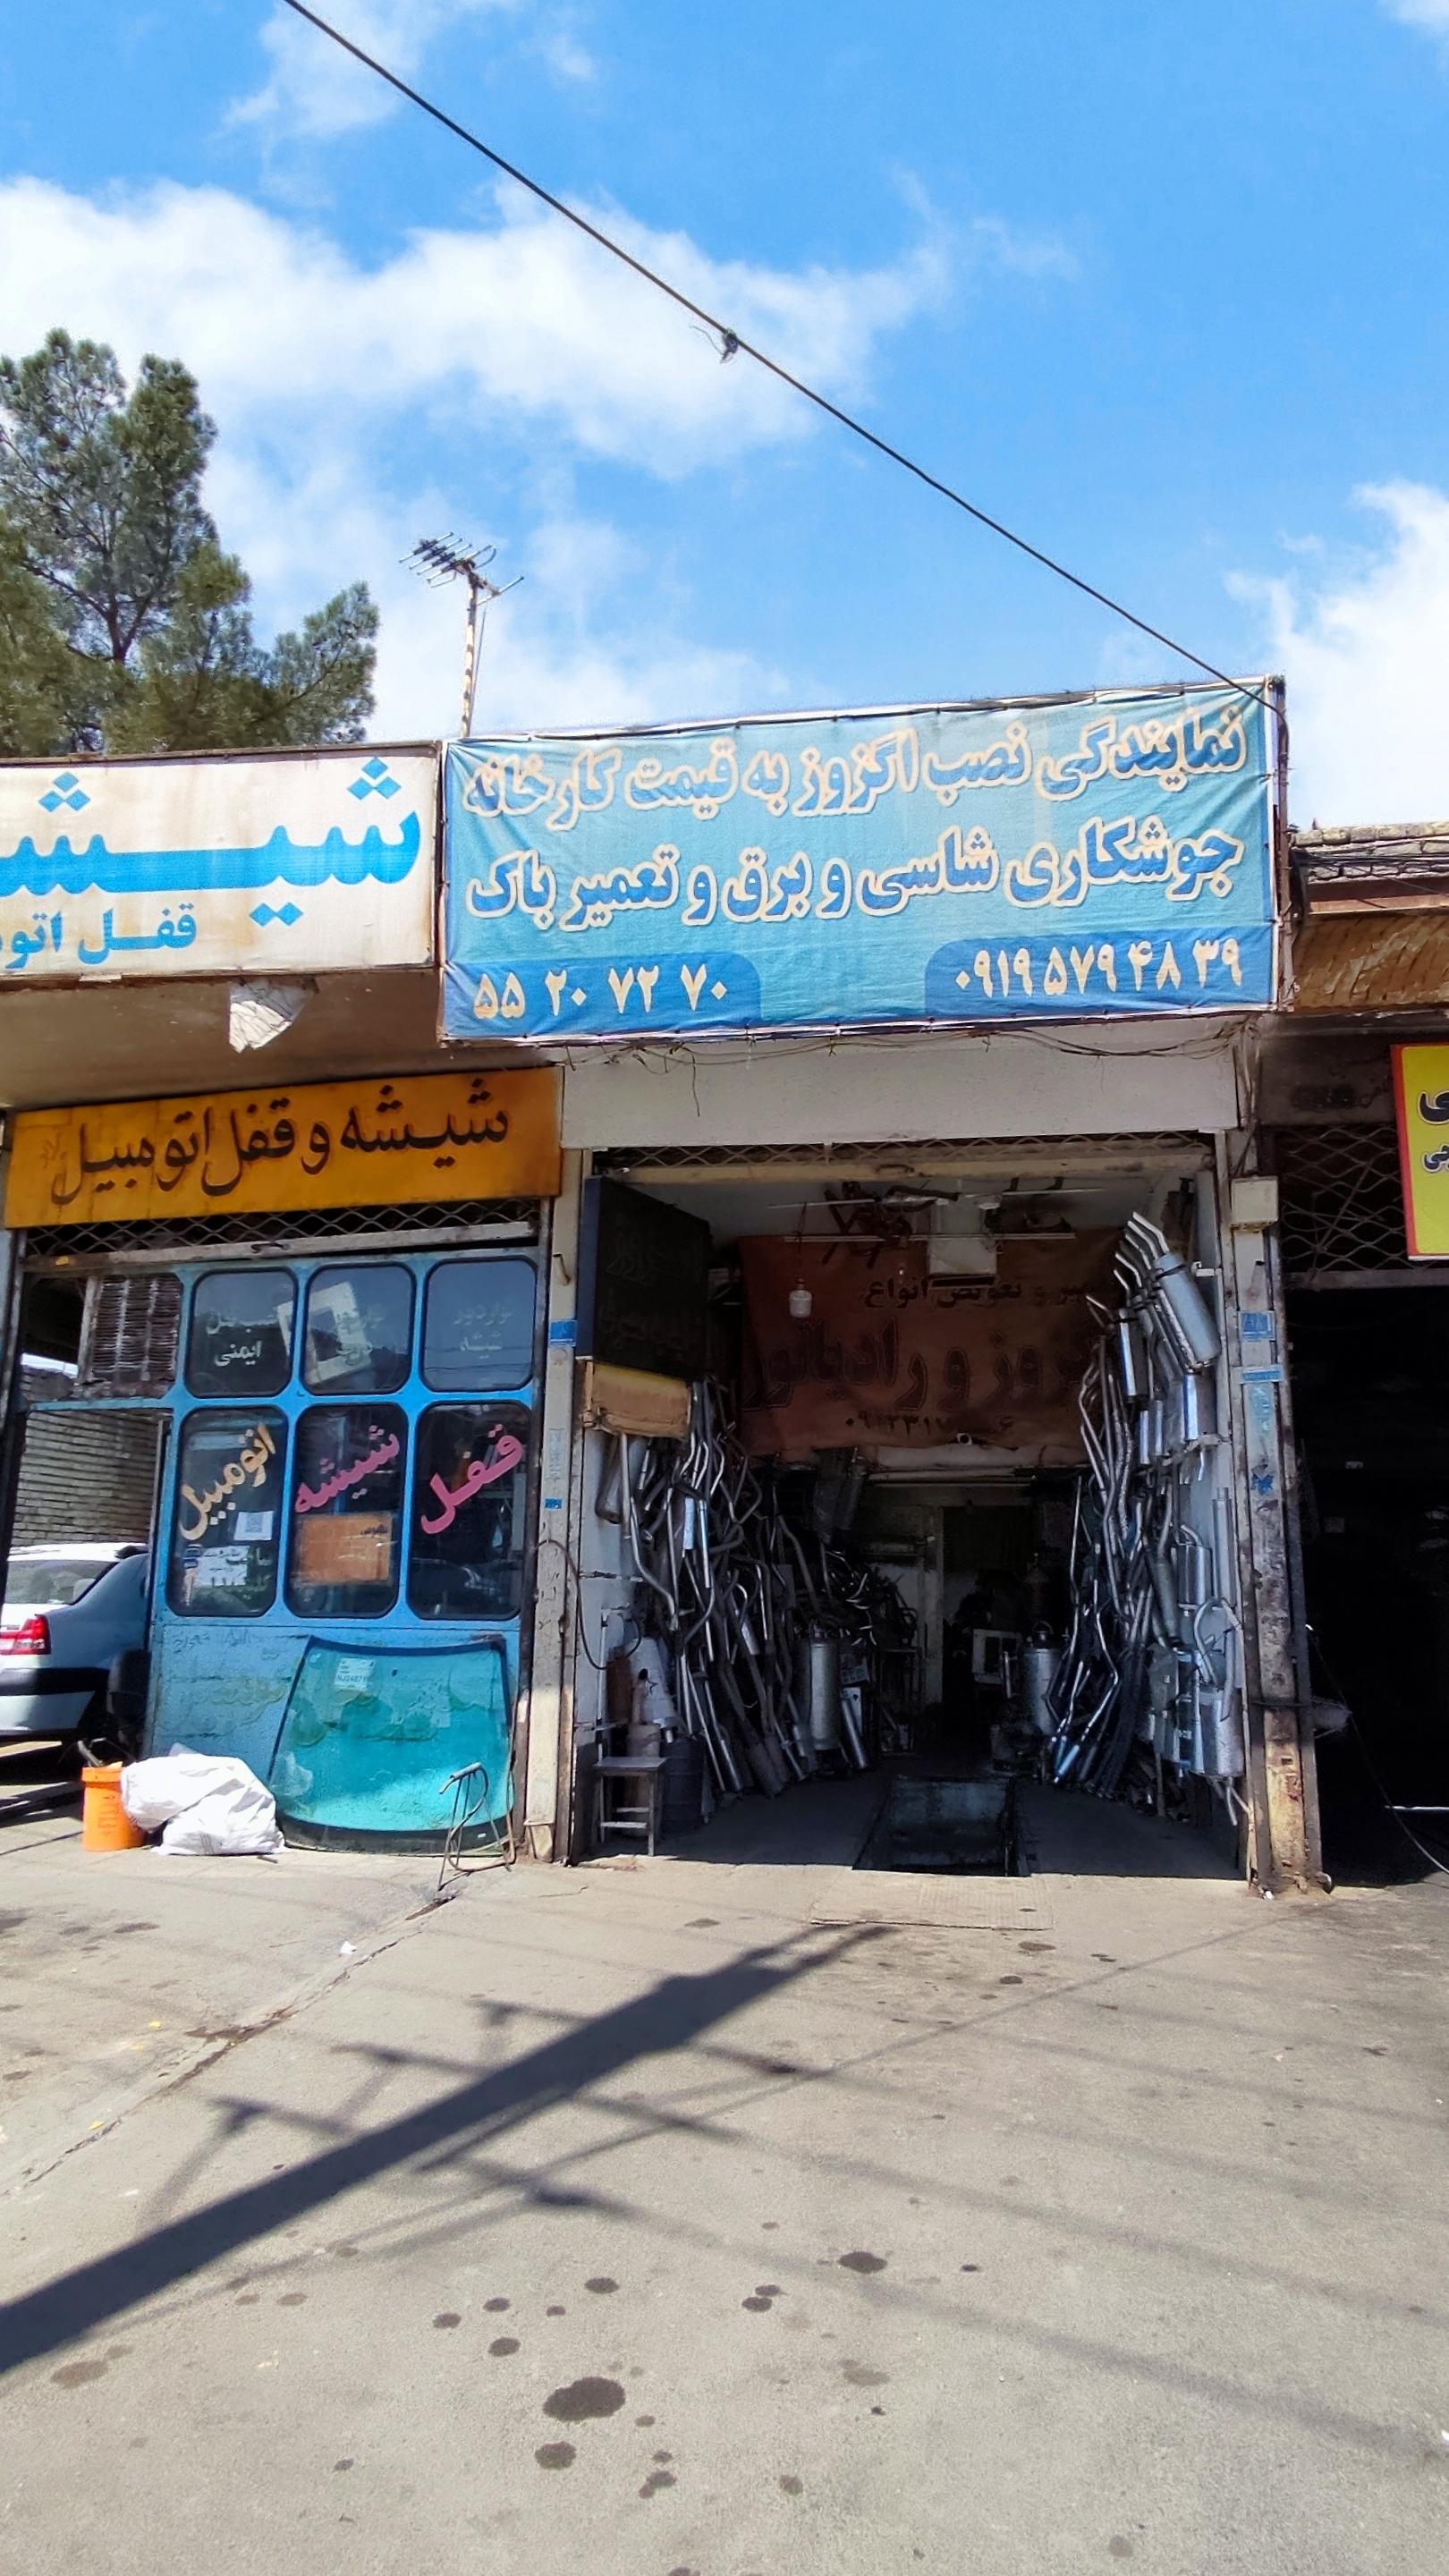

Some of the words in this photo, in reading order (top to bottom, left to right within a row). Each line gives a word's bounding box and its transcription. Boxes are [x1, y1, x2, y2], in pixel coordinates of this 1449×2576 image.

[463, 748, 623, 831] کارخانه
[625, 737, 740, 820] قیمت
[741, 750, 790, 817] به
[792, 727, 919, 817] اگزوز
[923, 720, 1033, 806] نصب
[1037, 706, 1246, 801] نمایندگی
[0, 756, 420, 927] شیش
[722, 846, 813, 923] برق
[857, 824, 999, 917] شاسی
[1004, 815, 1244, 909] جوشکاری
[466, 848, 556, 930] باک
[559, 843, 681, 932] تعمیر
[682, 864, 717, 926] و
[816, 857, 853, 919] و
[0, 910, 64, 970] اتو
[77, 902, 198, 965] قفل
[51, 1106, 211, 1205] اتومبیل
[200, 1097, 297, 1197] قفل
[301, 1121, 332, 1175] و
[340, 1078, 510, 1168] شیشه
[865, 1276, 929, 1309] انواع
[215, 1340, 262, 1367] ایمنی
[180, 1422, 275, 1541] اتومبیل
[295, 1424, 400, 1513] شیشه
[420, 1422, 525, 1535] قفل
